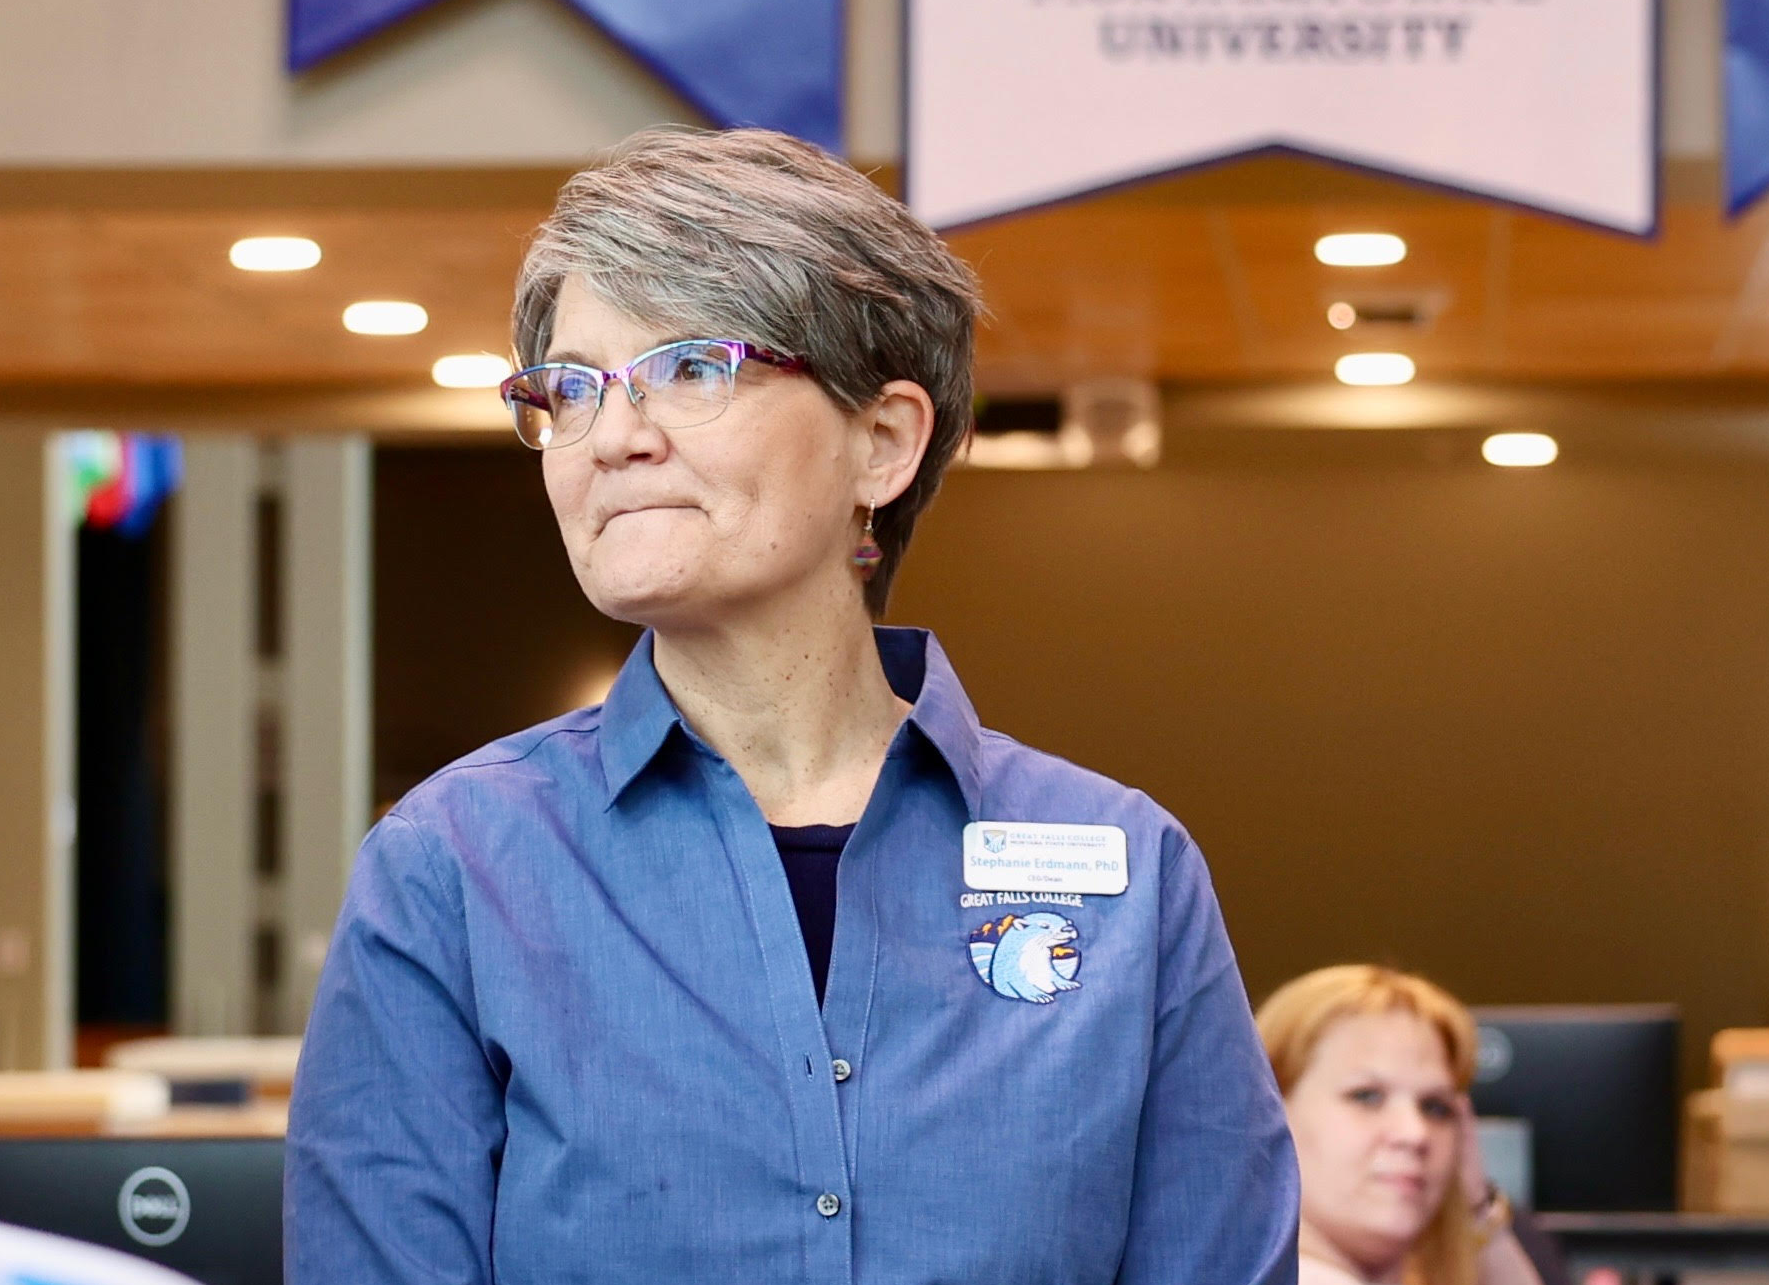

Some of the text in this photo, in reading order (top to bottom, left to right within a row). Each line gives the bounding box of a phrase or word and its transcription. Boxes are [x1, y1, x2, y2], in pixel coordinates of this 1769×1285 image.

[1096, 15, 1470, 62] UNIVERSITY
[1010, 832, 1037, 840] GREAT
[1067, 834, 1106, 843] COLLEGE
[970, 855, 1119, 872] Stephanie Erdmann, PhD
[960, 891, 1084, 908] GREAT FALLS COLLEGE
